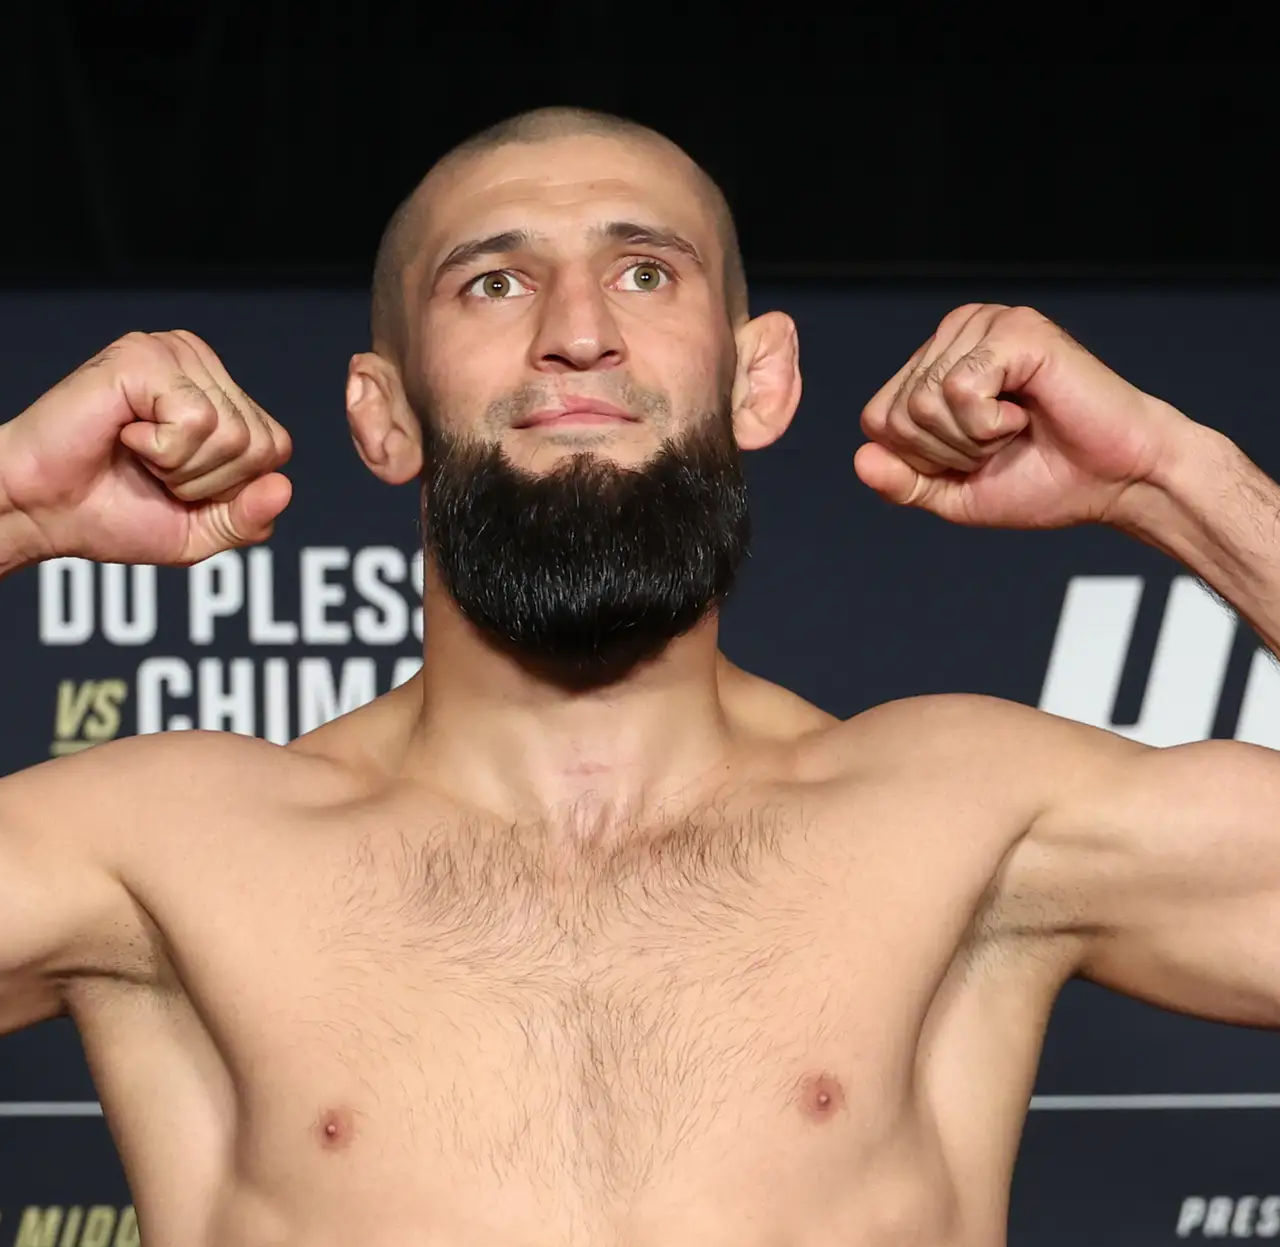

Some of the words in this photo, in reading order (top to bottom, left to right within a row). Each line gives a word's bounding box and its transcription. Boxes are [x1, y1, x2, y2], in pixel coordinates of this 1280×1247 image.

[38, 556, 157, 645] DU
[188, 545, 424, 645] PLES
[56, 679, 127, 740] VS
[136, 656, 424, 747] CHIM
